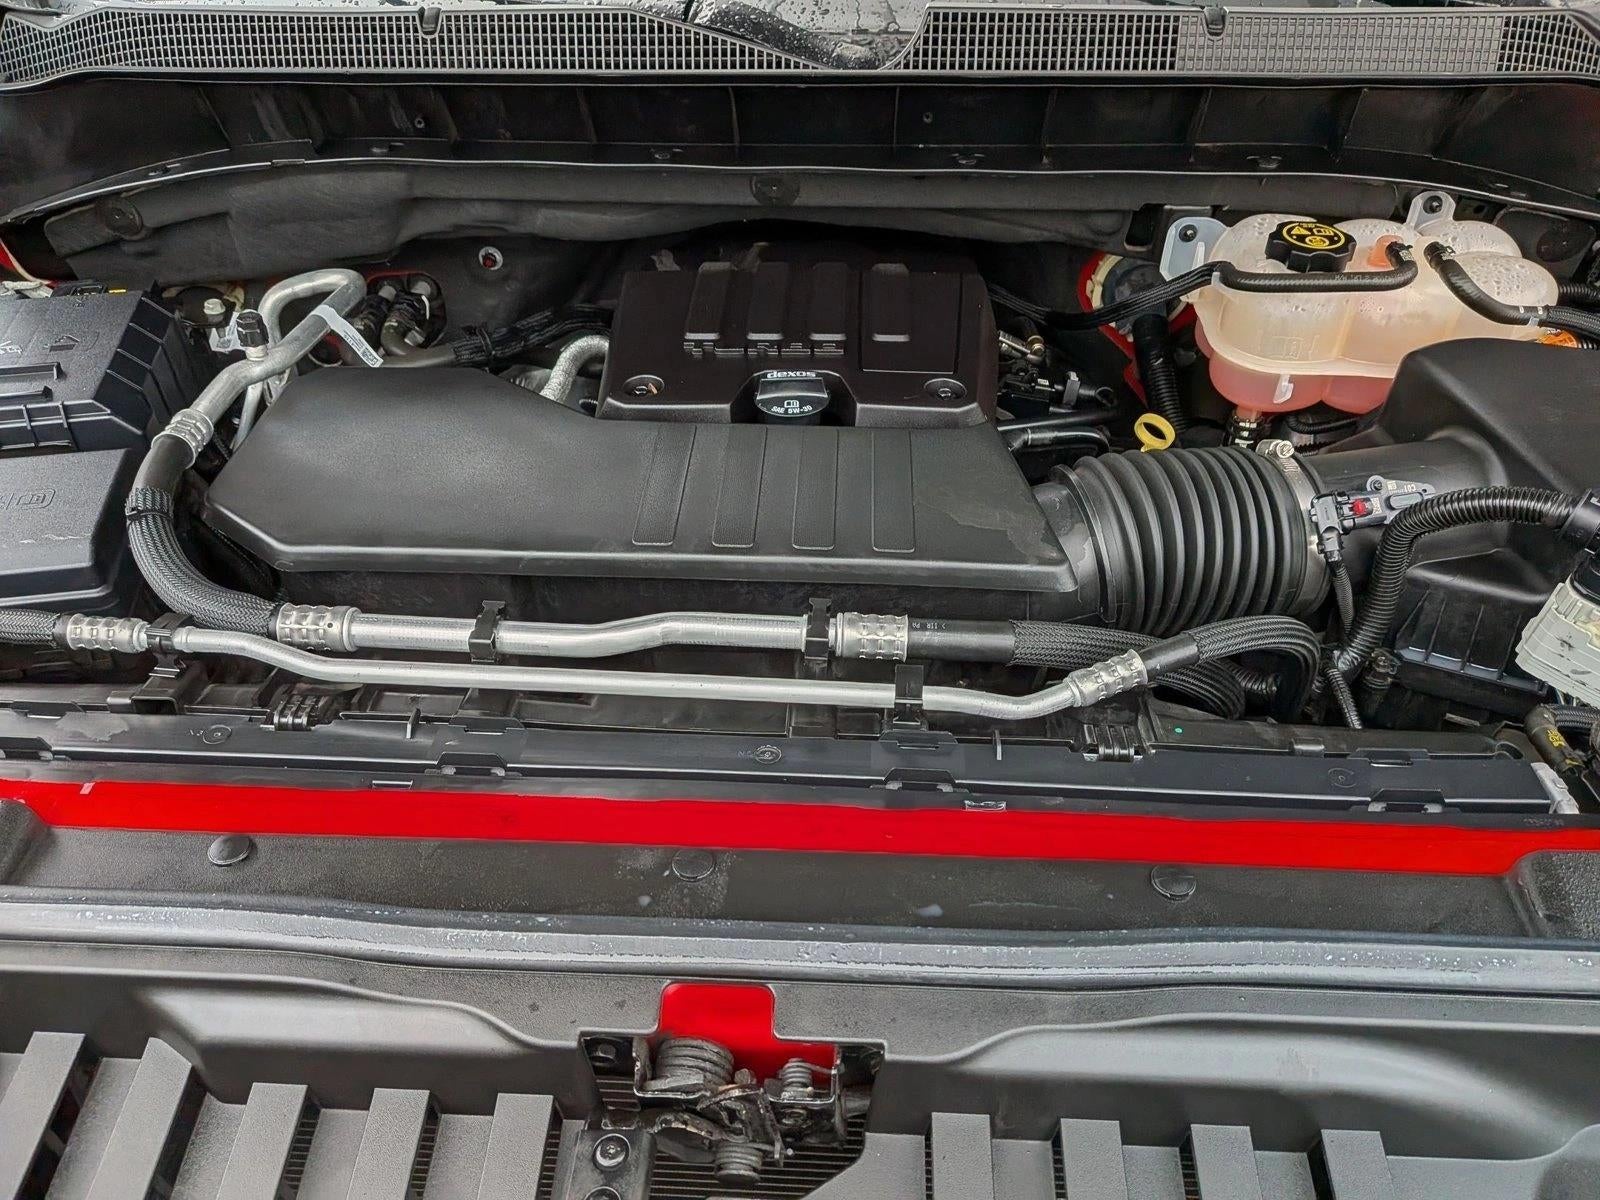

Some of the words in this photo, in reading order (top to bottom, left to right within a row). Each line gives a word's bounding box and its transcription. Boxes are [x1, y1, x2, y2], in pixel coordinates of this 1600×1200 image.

[767, 370, 816, 379] dexos
[771, 405, 785, 414] SAE
[788, 404, 813, 414] 5W-30
